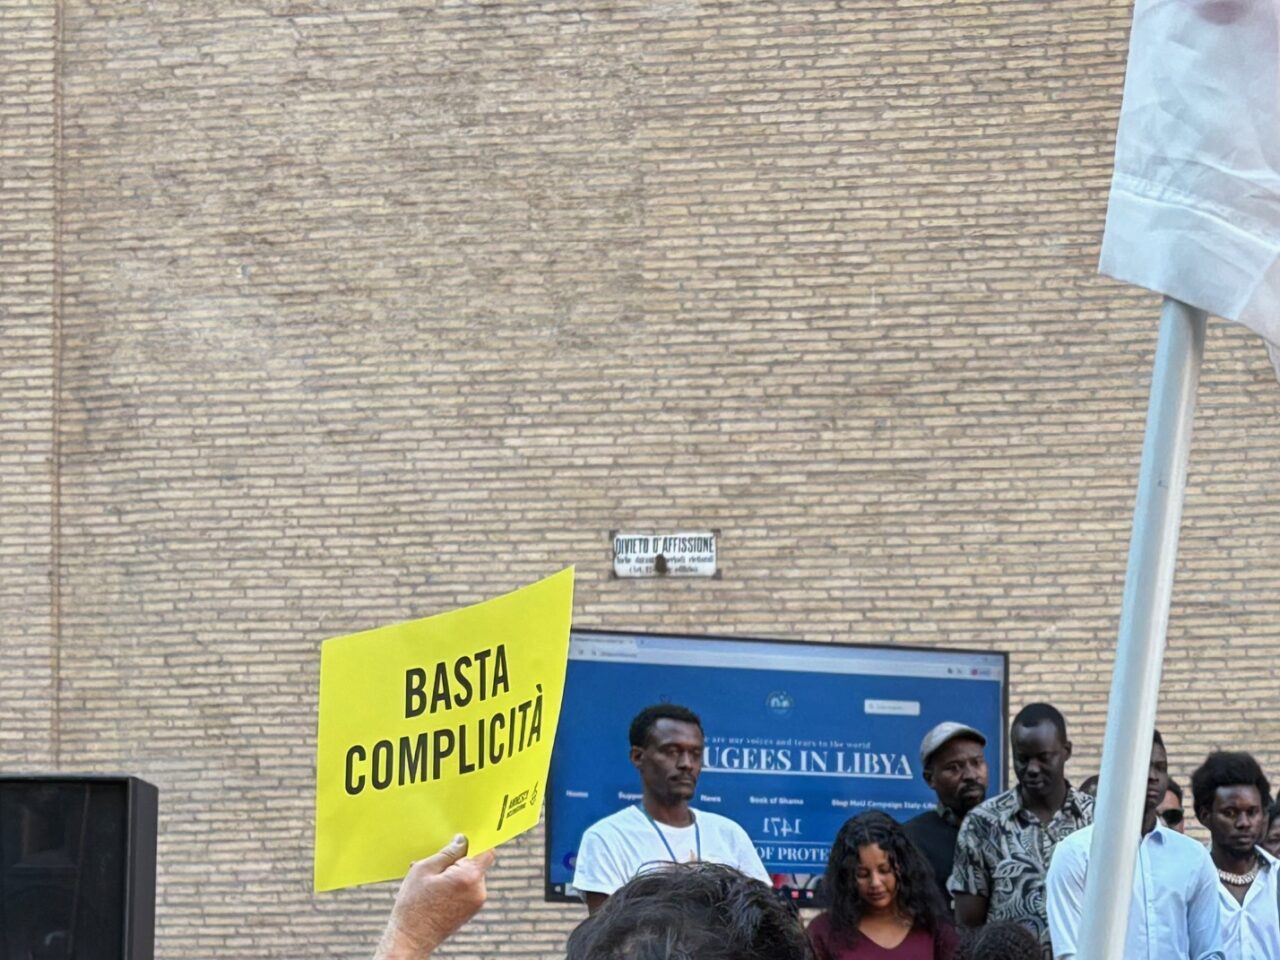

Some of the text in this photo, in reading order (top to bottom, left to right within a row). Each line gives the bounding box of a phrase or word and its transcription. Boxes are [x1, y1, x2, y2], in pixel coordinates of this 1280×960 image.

[615, 536, 715, 554] DIVIETO D'AFFISSIONE
[404, 644, 510, 719] BASTA
[344, 683, 544, 796] COMPLICITÀ
[703, 746, 913, 775] UGEES IN LIBYA
[778, 848, 832, 861] PROTE
